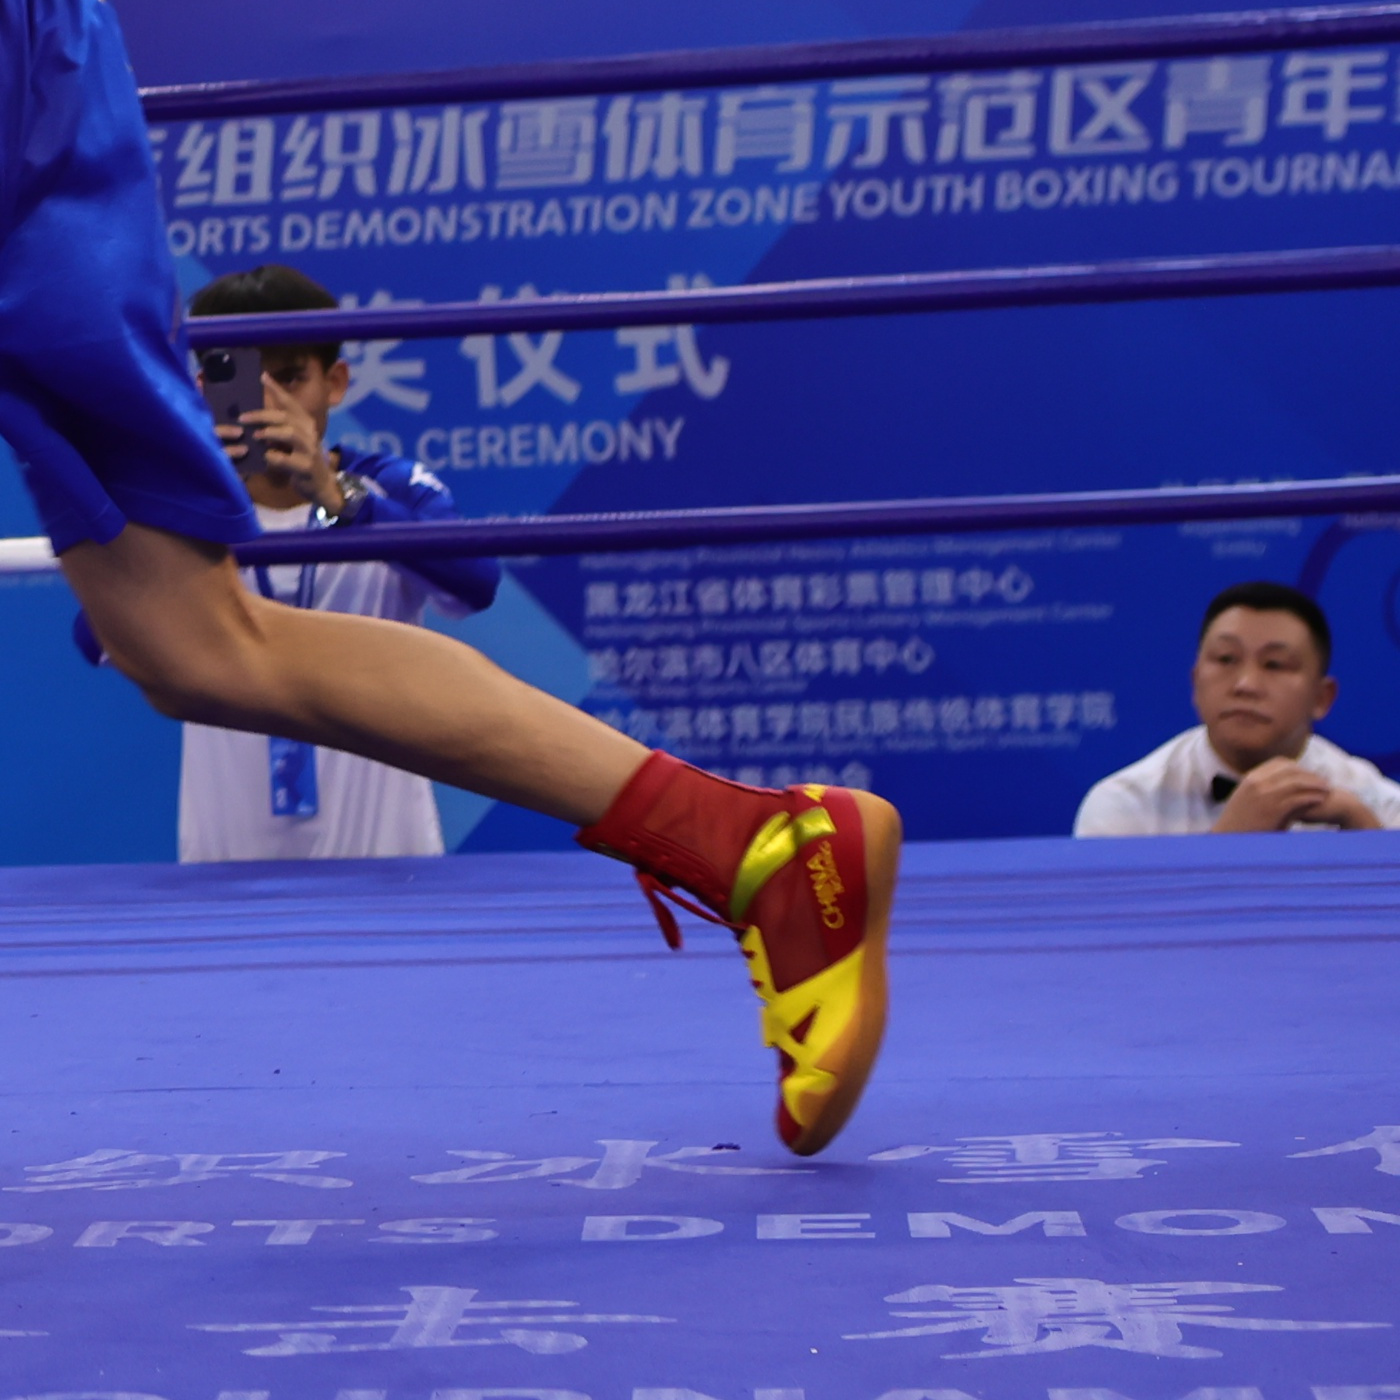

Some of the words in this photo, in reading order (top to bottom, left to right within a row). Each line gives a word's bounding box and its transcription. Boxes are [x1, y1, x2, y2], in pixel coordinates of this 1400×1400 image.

[280, 189, 678, 252] DEMONSTRATION
[688, 181, 820, 231] ZONE
[829, 171, 985, 221] YOUTH
[994, 161, 1180, 213] BOXING
[1190, 149, 1400, 200] TOURNA
[414, 416, 686, 471] CEREMONY
[587, 635, 935, 684] 哈尔滨市八区体育中心
